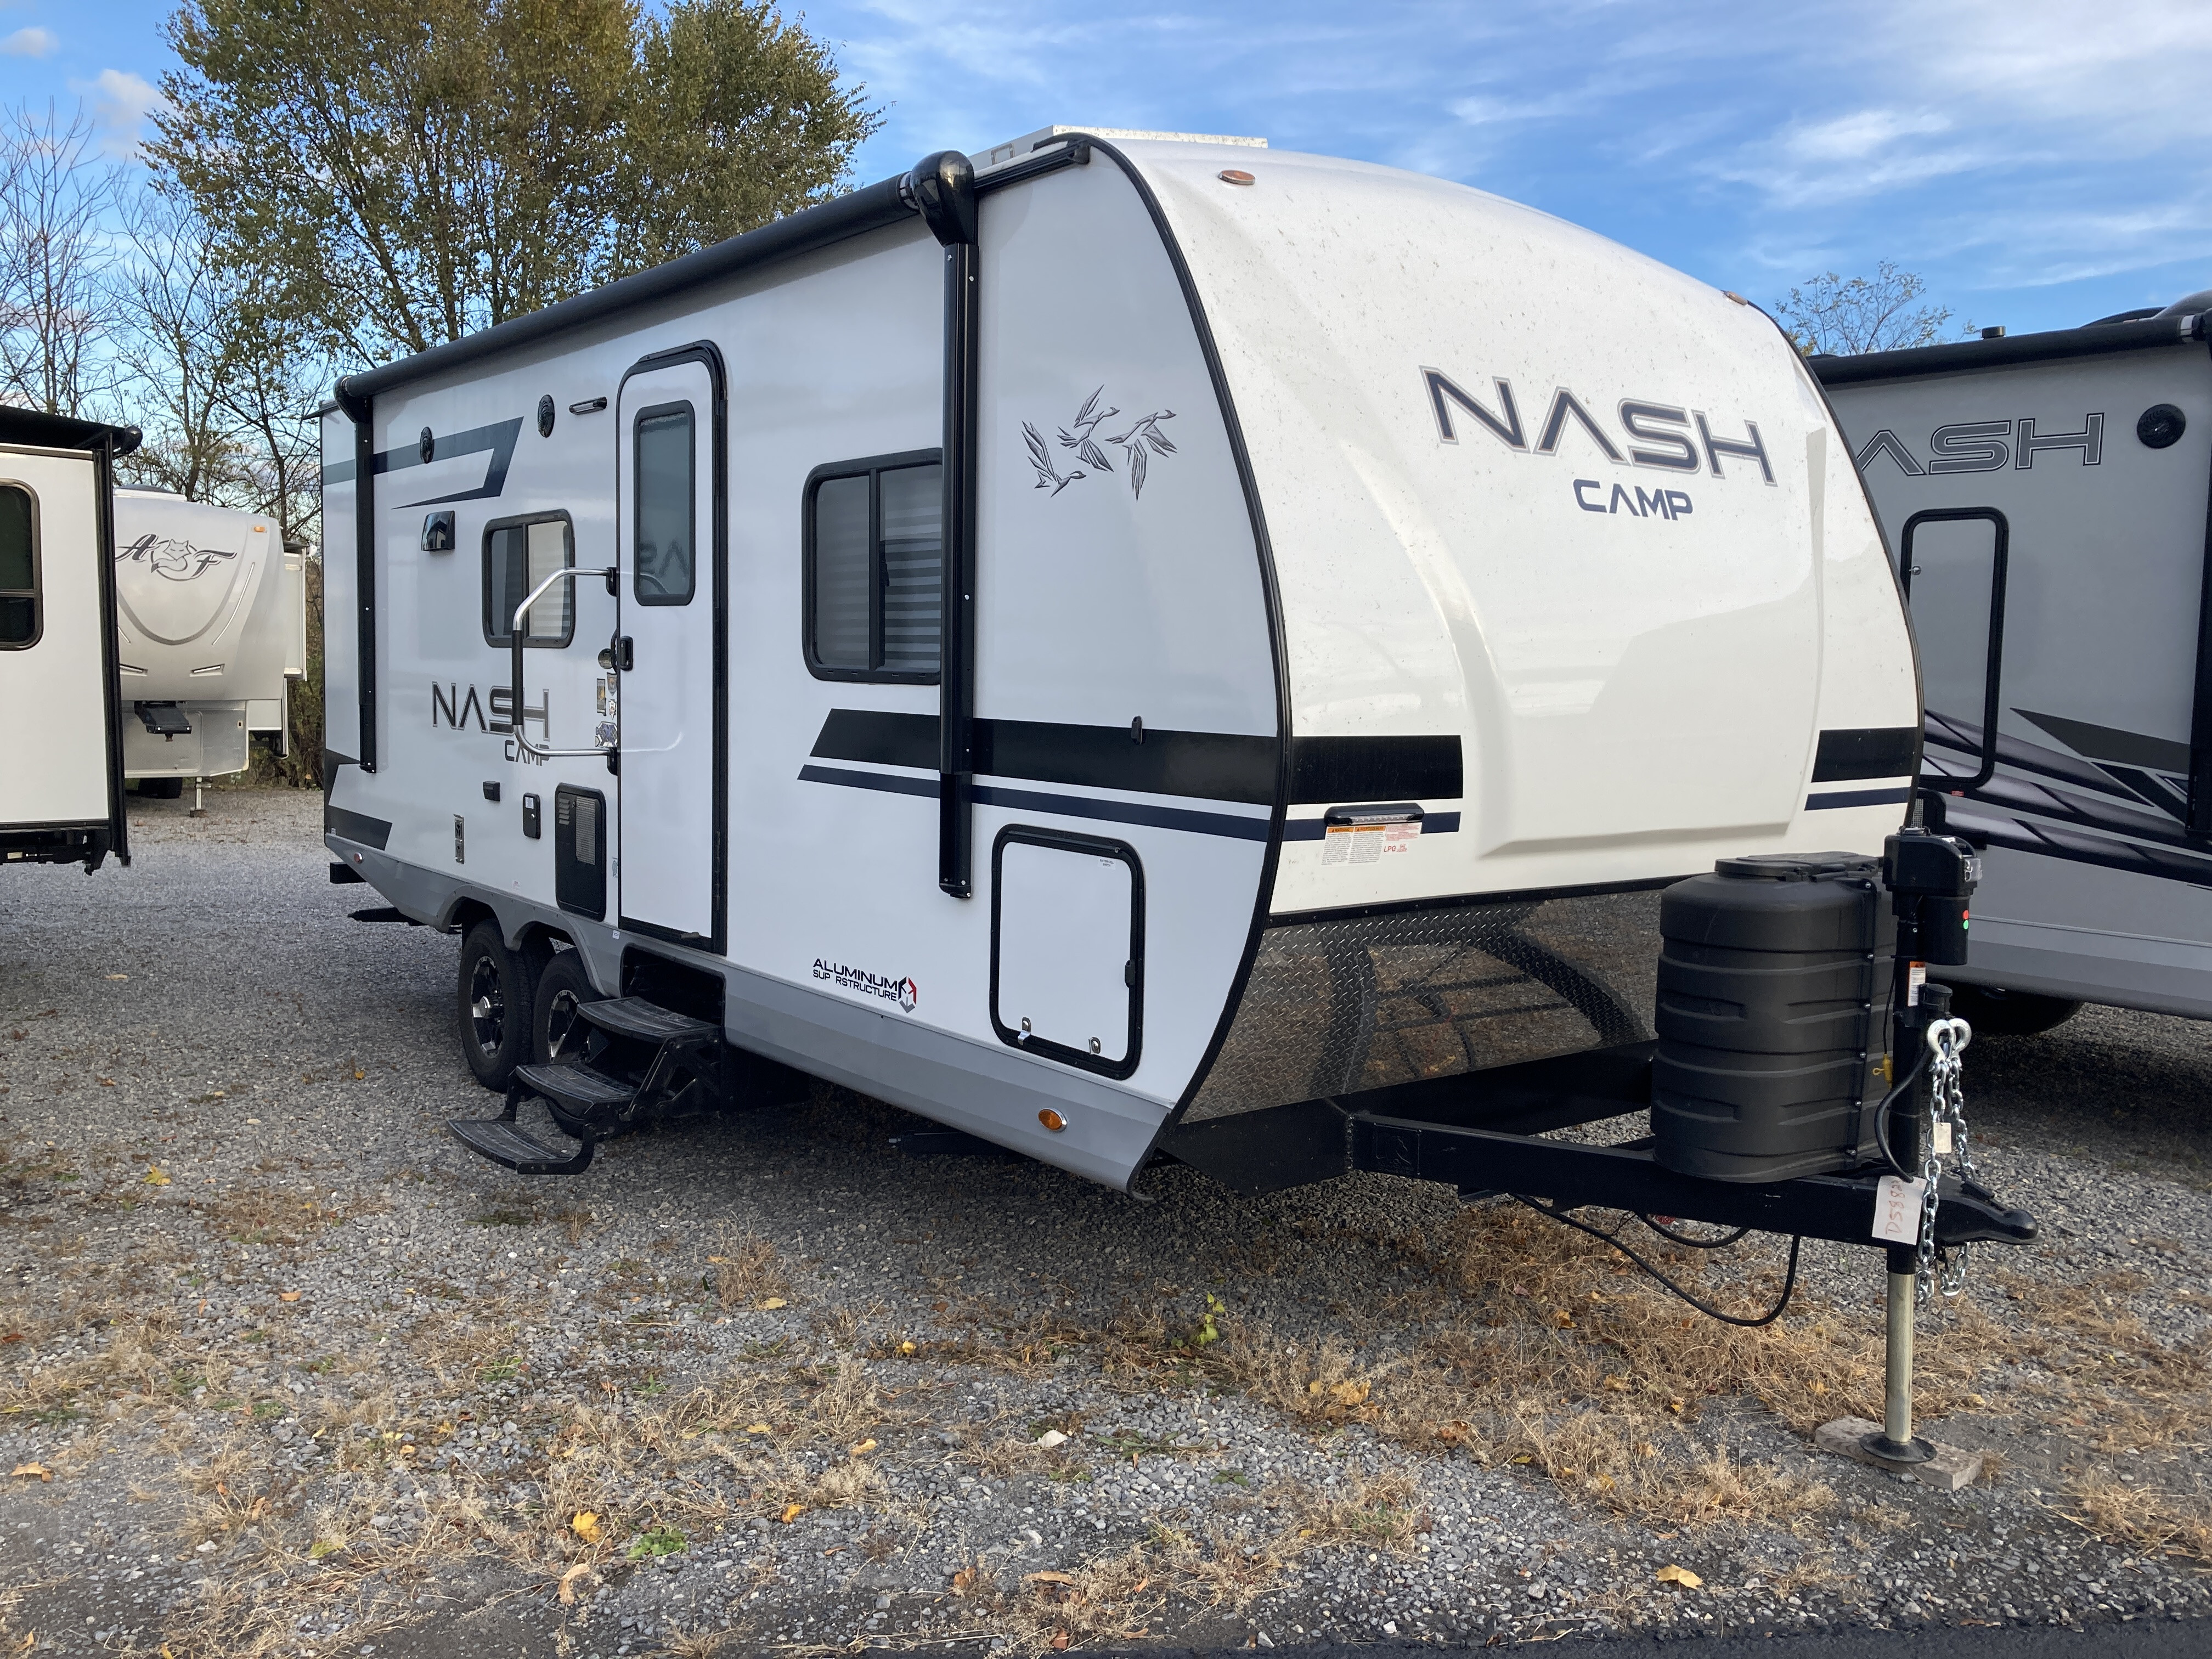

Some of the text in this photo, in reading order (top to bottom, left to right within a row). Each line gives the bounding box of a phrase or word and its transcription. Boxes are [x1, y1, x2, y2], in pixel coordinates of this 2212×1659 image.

[1419, 365, 1778, 487] NASH
[1857, 413, 2104, 476] ASH
[1573, 479, 1693, 521] CAMP
[432, 681, 550, 742] NASH
[813, 958, 898, 991] ALUMINUM
